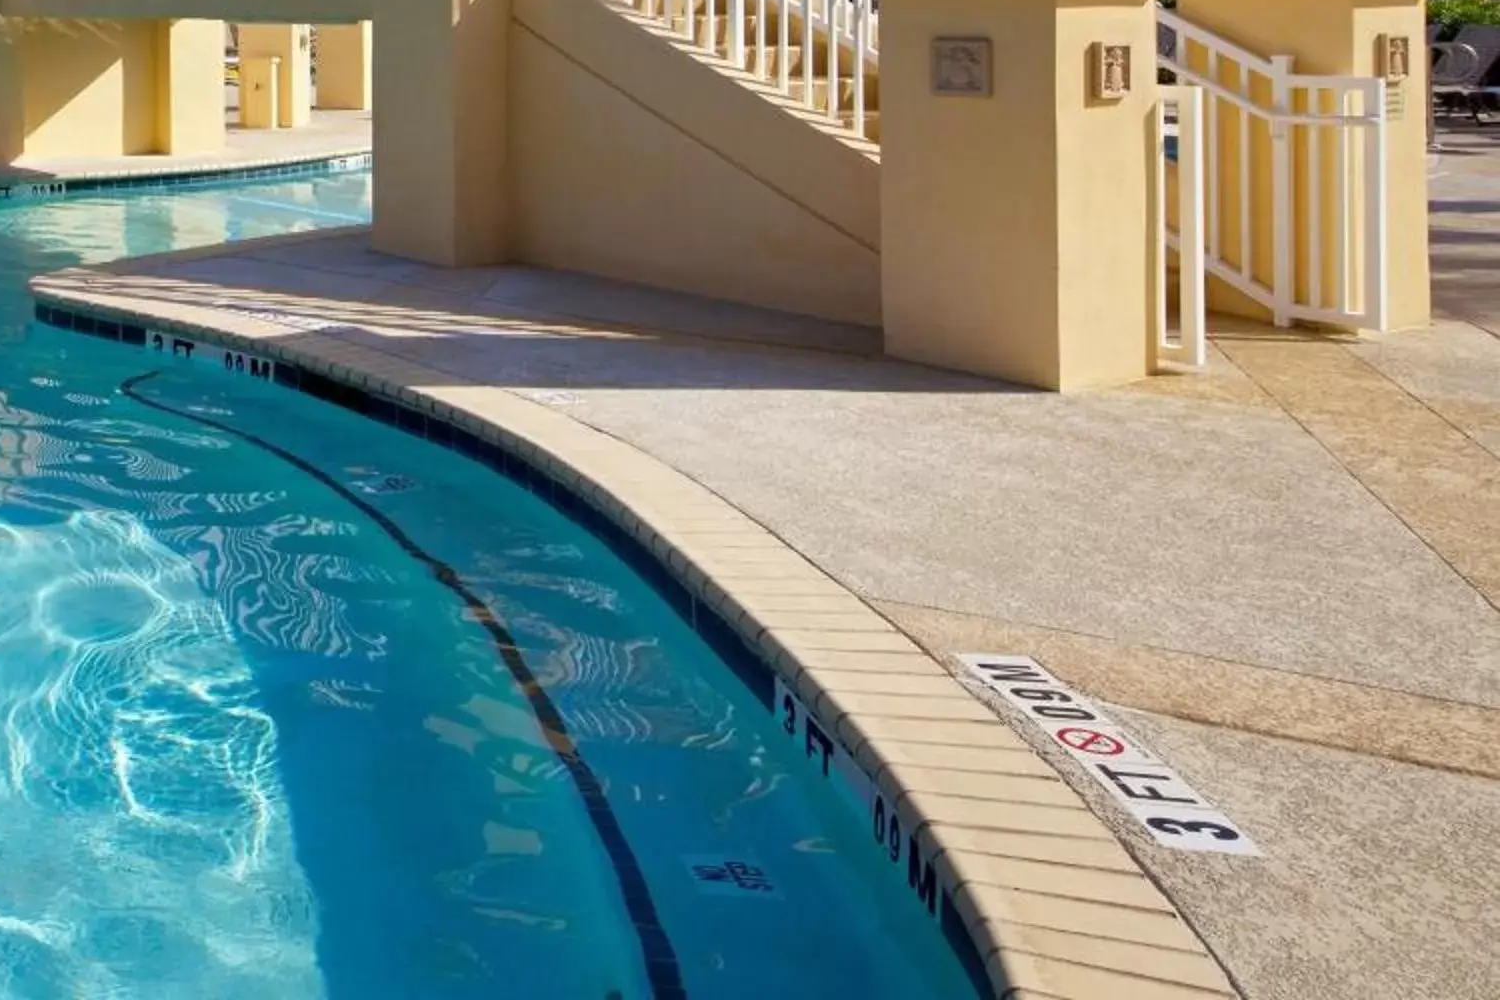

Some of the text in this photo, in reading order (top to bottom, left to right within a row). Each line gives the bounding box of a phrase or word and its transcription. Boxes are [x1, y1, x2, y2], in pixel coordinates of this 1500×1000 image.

[783, 694, 795, 735] 3
[806, 717, 833, 777] FT
[1095, 763, 1198, 804] FT
[1146, 816, 1239, 841] 3
